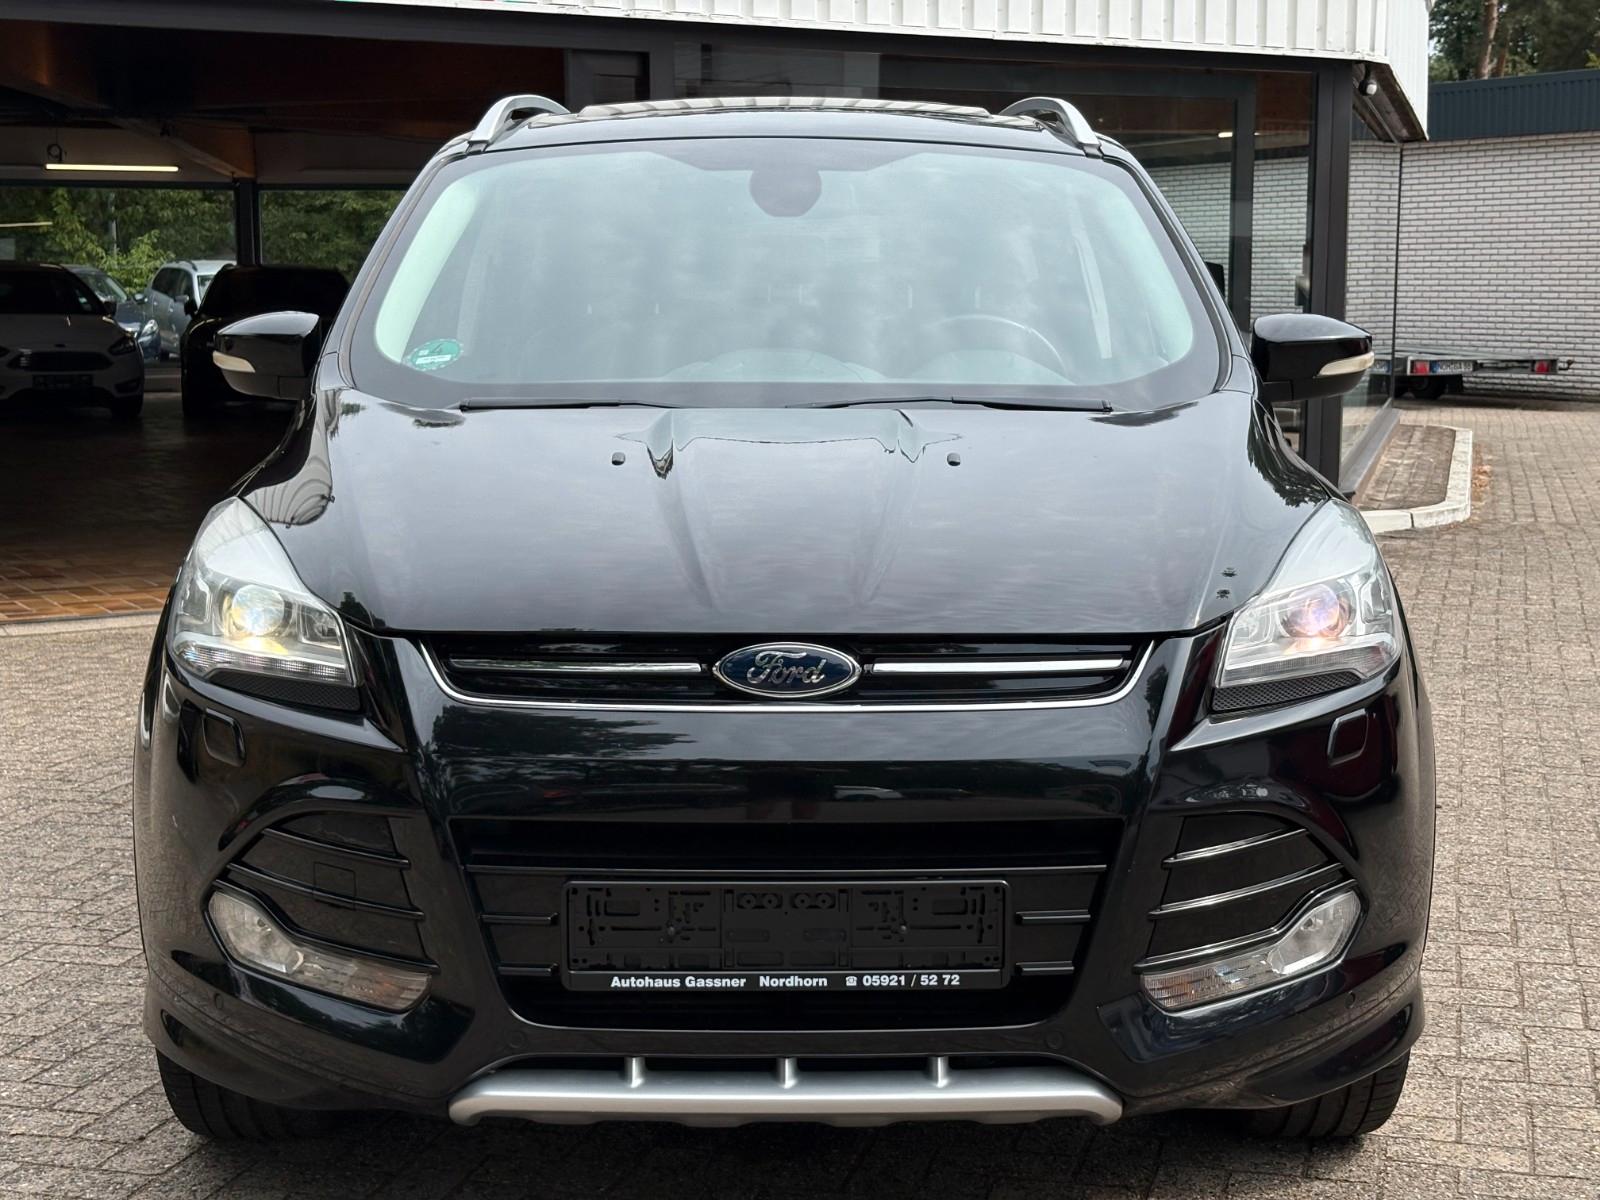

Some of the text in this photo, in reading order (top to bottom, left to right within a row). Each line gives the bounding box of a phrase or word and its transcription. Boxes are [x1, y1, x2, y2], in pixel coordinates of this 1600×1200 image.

[747, 651, 826, 684] Ford
[610, 976, 681, 988] Autohaus
[685, 975, 747, 988] Gassner
[759, 975, 828, 987] Nordhorn
[862, 974, 905, 986] 05921
[920, 974, 938, 986] 52
[942, 974, 960, 986] 72
